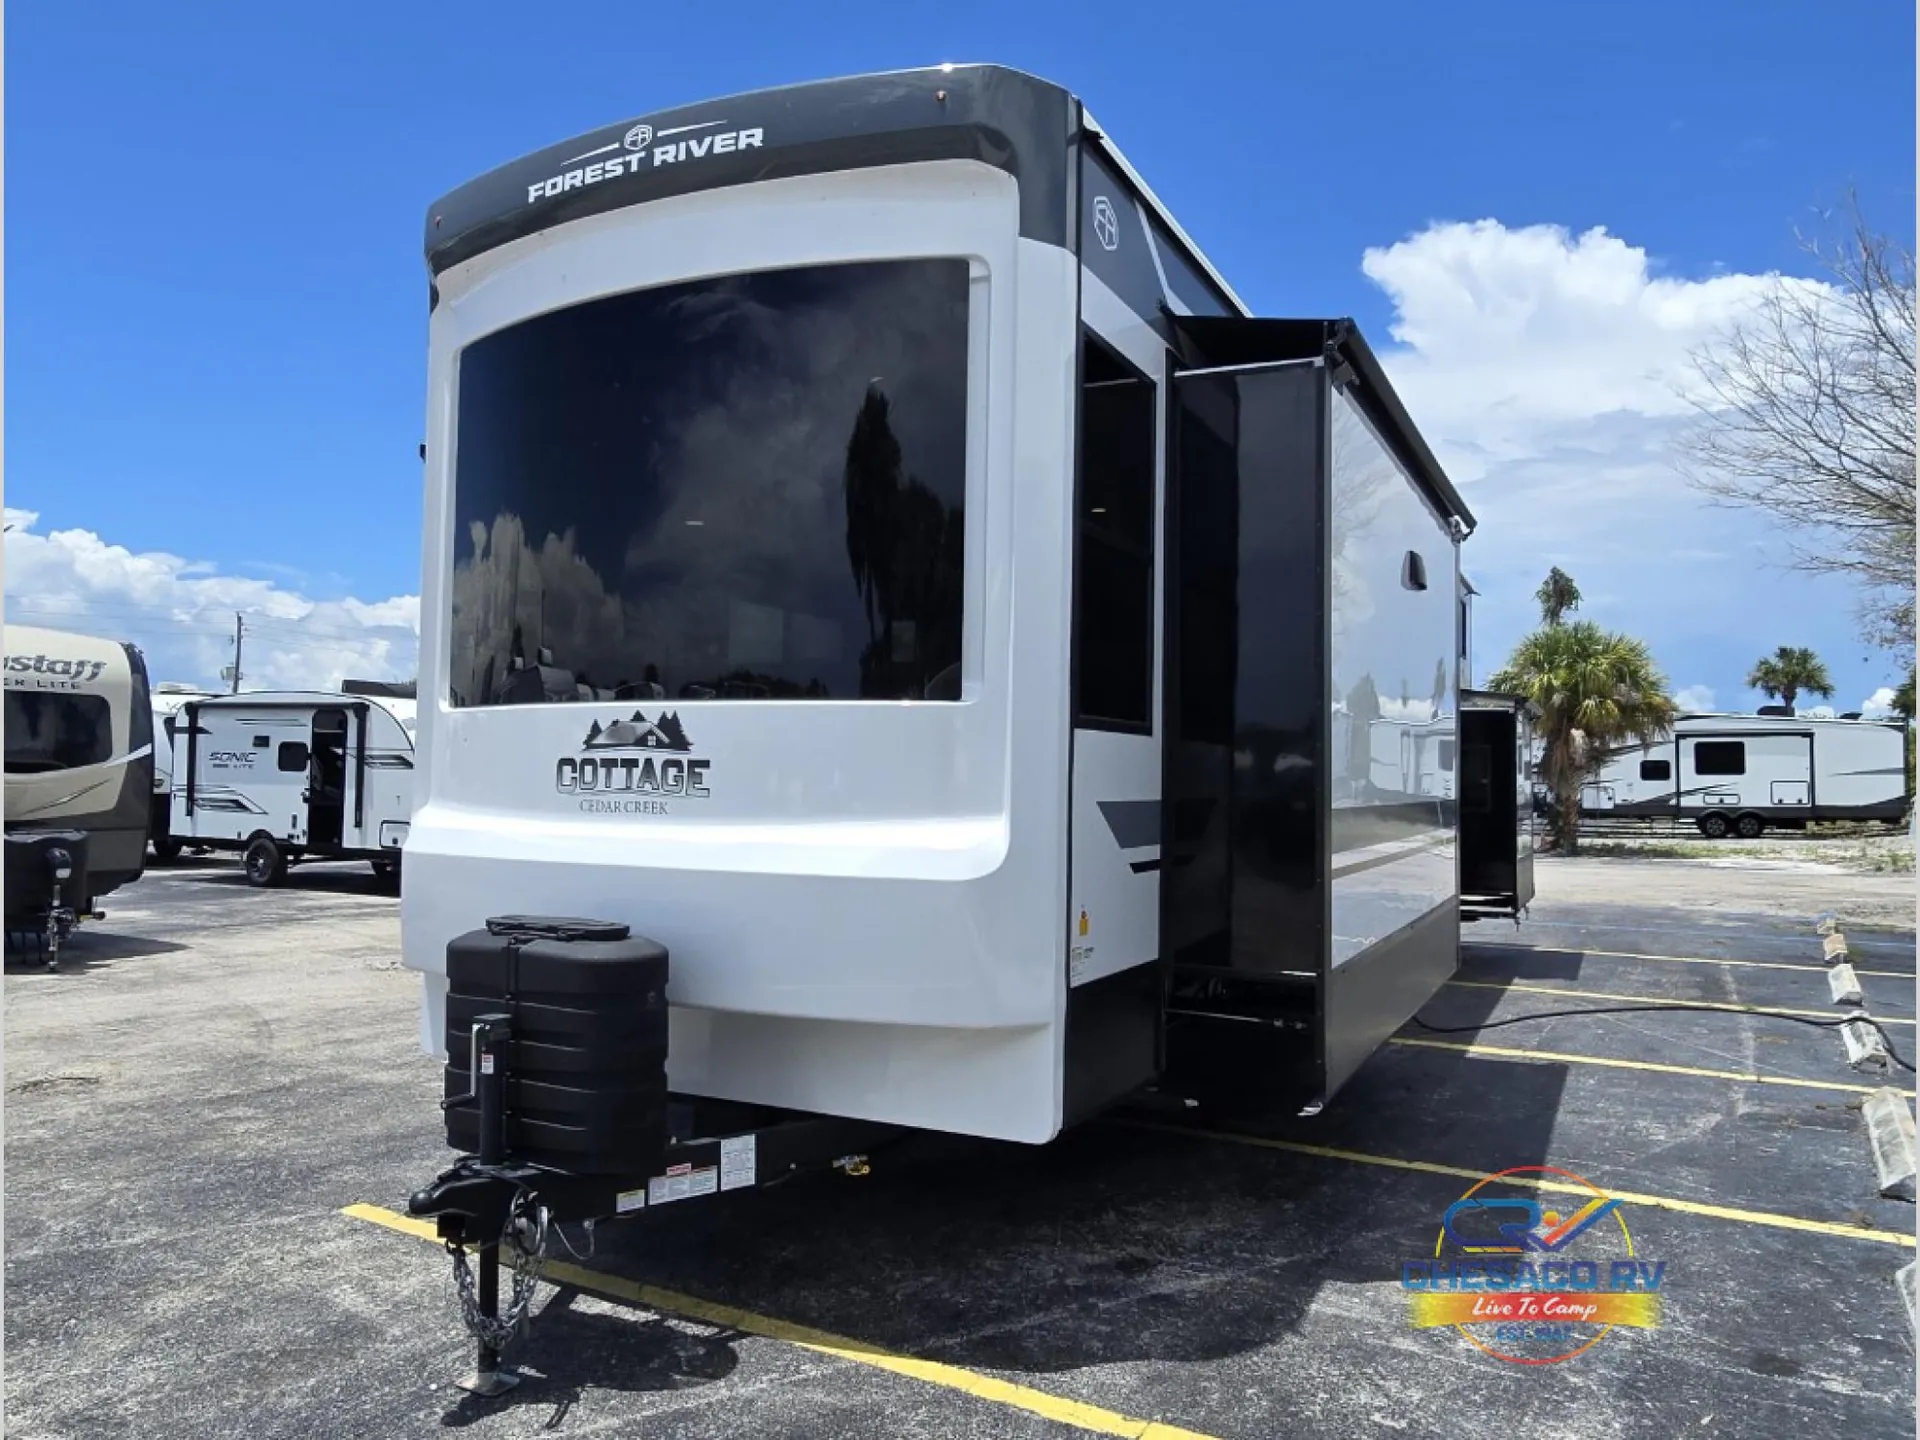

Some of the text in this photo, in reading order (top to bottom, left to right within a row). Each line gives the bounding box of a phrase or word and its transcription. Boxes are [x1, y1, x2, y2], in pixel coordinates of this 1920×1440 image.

[527, 128, 764, 203] FOREST RIVER
[209, 752, 257, 763] SONIC
[556, 757, 711, 799] COTTAGE
[580, 799, 668, 815] CEDAR CREEK
